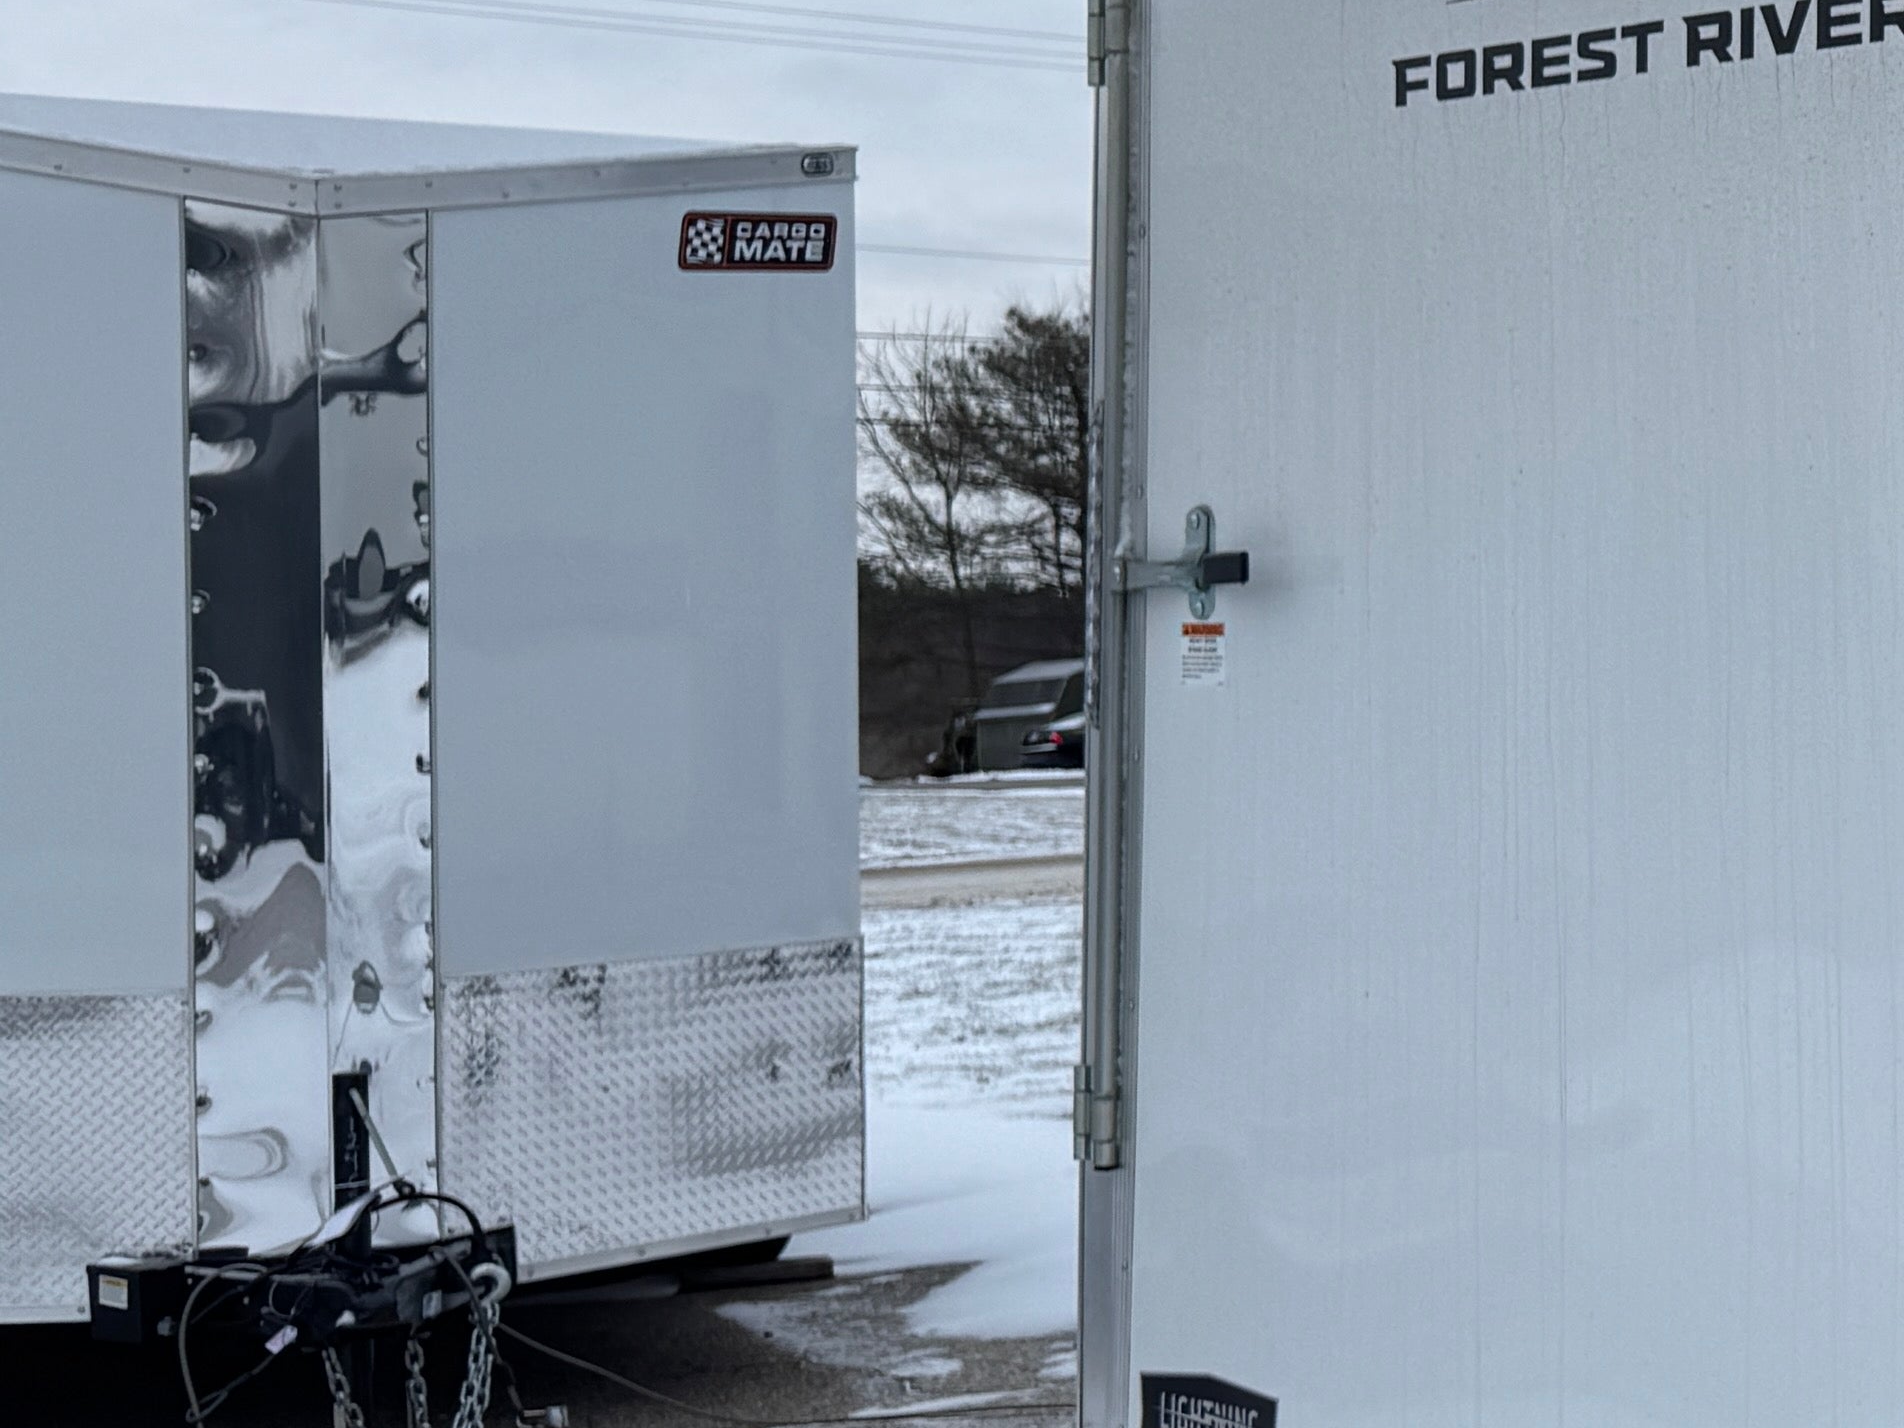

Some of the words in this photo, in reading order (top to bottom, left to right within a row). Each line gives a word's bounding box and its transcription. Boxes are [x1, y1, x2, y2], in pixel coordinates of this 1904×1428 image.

[1391, 19, 1665, 107] FOREST
[736, 221, 826, 240] CARGO
[733, 239, 825, 262] MATE
